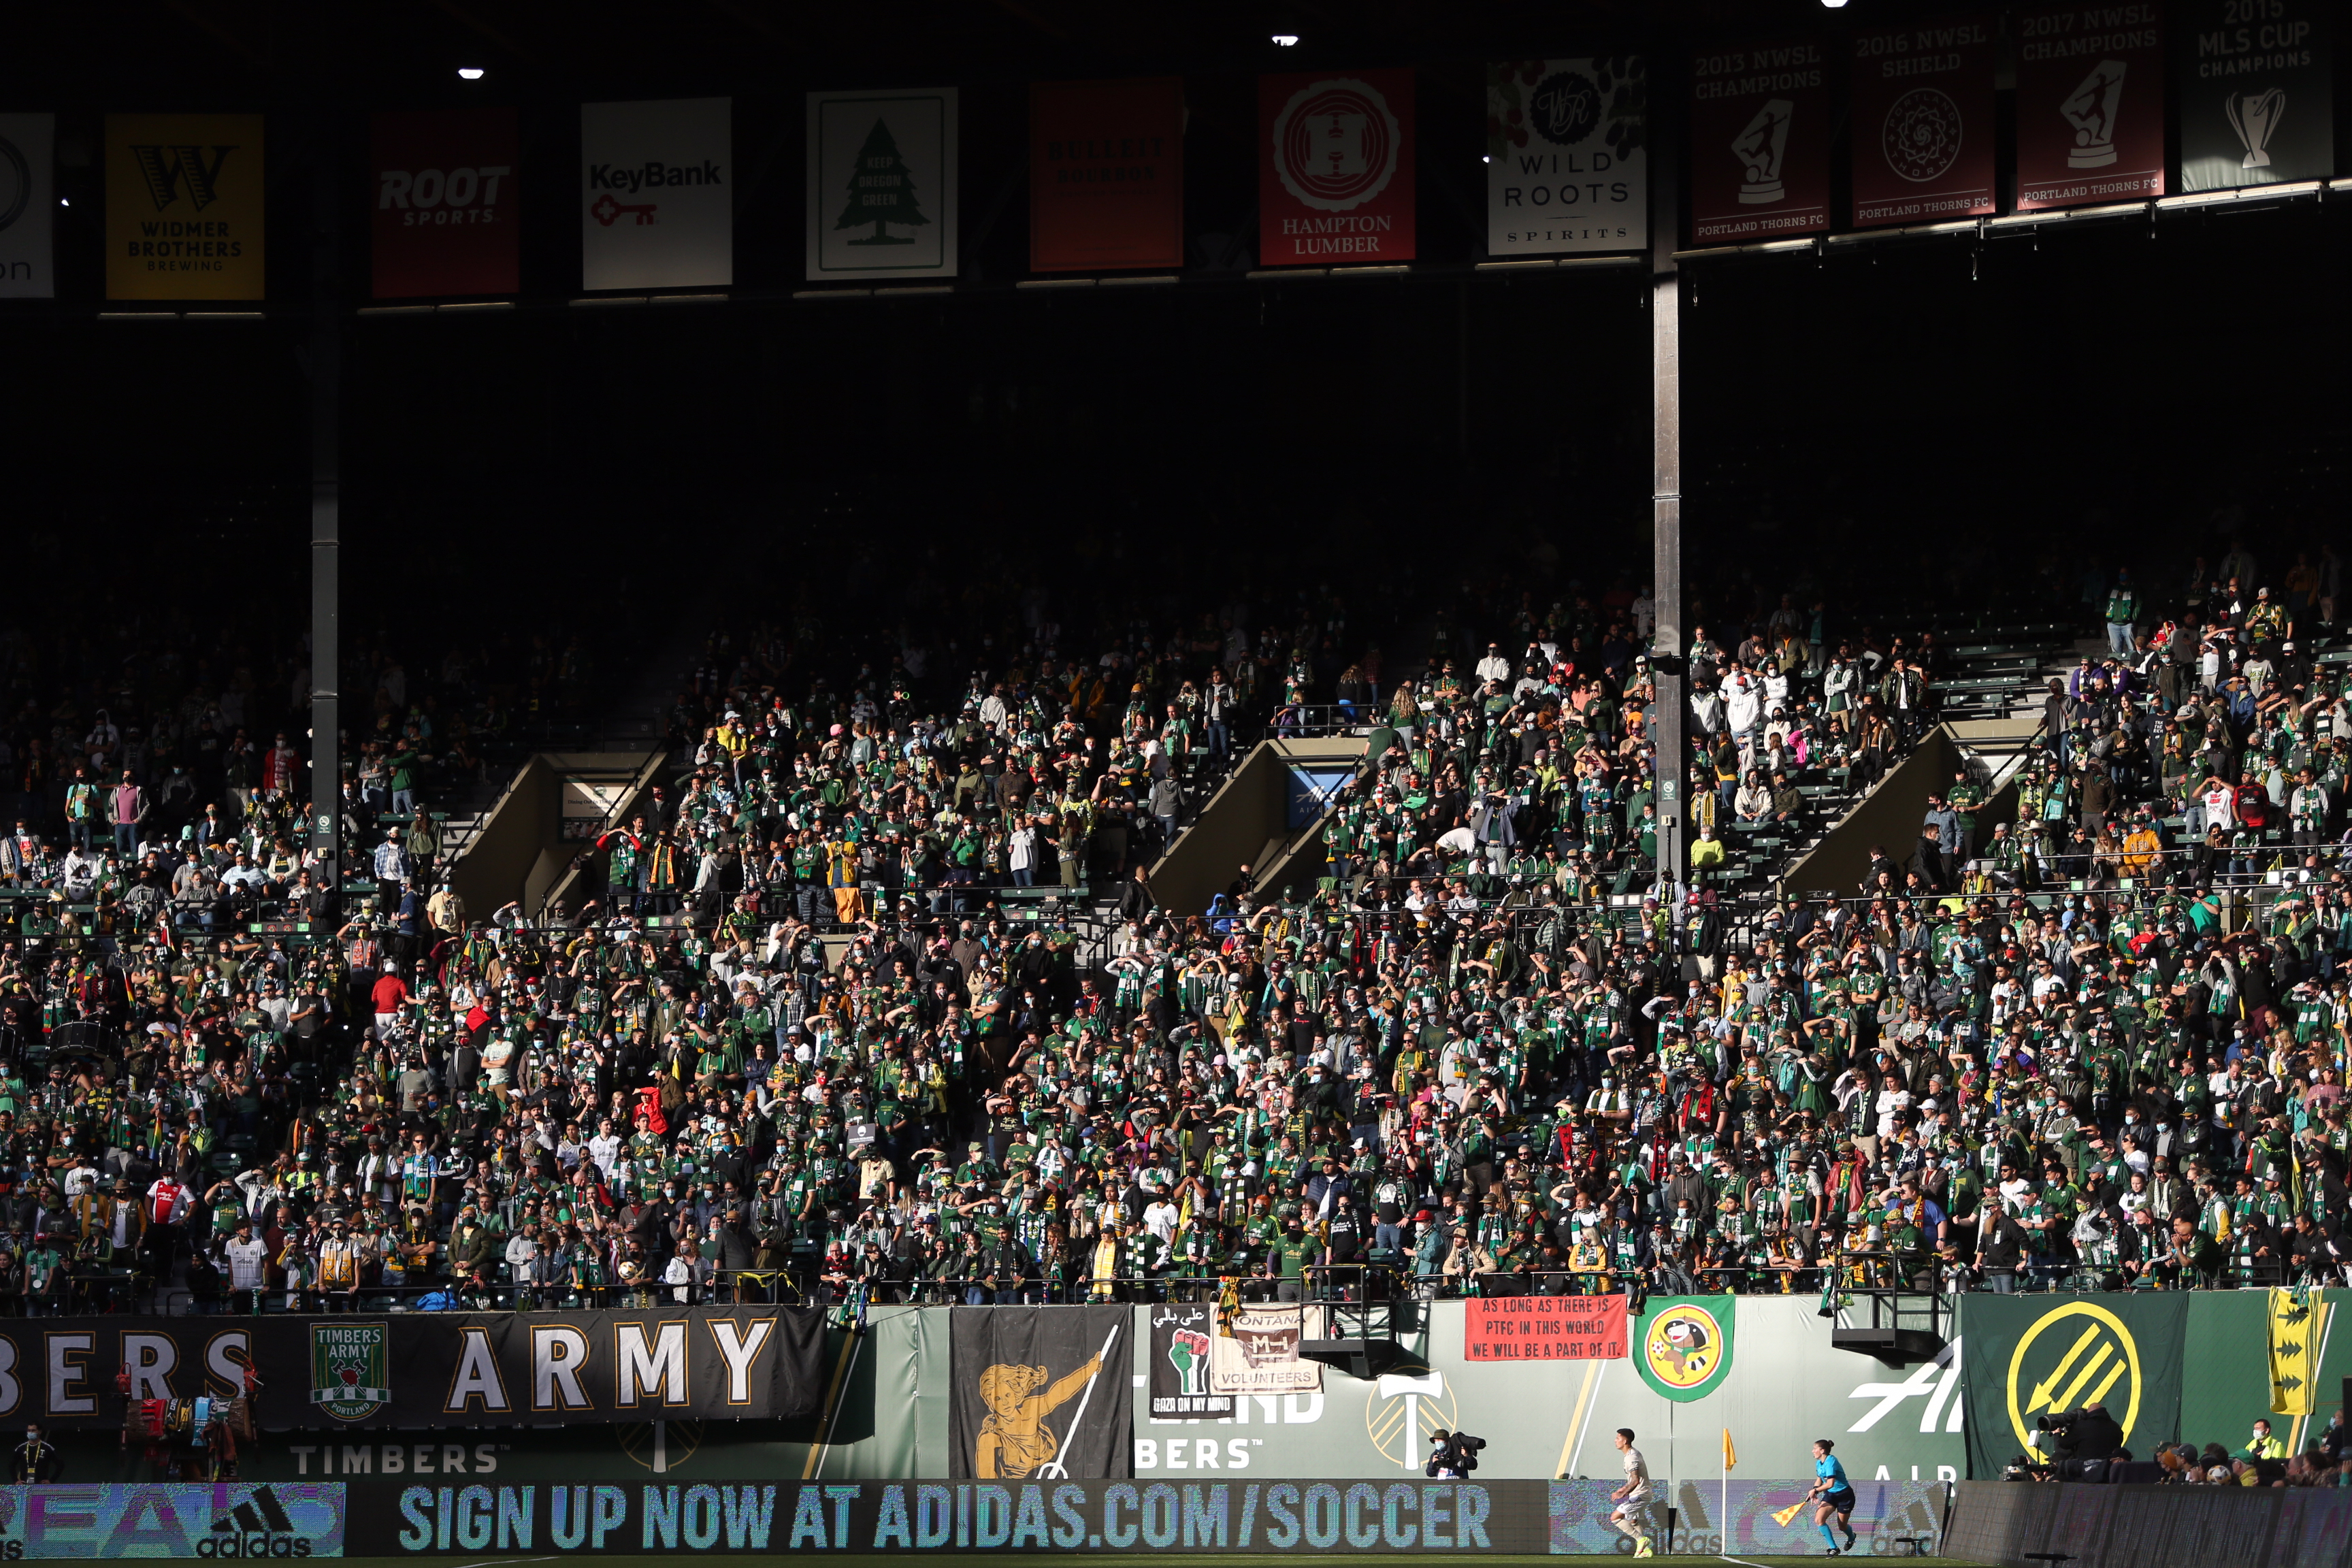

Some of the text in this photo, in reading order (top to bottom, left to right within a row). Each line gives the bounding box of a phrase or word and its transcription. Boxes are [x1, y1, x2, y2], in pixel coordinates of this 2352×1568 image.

[2022, 3, 2156, 37] 2017 NWSL
[2224, 0, 2284, 24] 2015
[1857, 24, 1987, 58] 2016 NWSL
[2022, 29, 2157, 61] CHAMPIONS
[2198, 21, 2310, 58] MLS CUP
[1695, 46, 1821, 77] 2013 NWSL
[1882, 53, 1961, 78] SHIELD
[2199, 50, 2311, 78] CHAMPIONS
[1695, 70, 1822, 100] CHAMPIONS
[866, 156, 894, 170] KEEP
[1518, 152, 1612, 175] WILD
[378, 165, 511, 210] ROOT
[590, 160, 723, 194] KeyBank
[858, 174, 902, 189] OREGON
[862, 193, 898, 207] GREEN
[1504, 182, 1629, 207] ROOTS
[2023, 178, 2158, 202] PORTLAND THORNS FC
[403, 208, 494, 227] SPORTS
[1858, 196, 1989, 220] PORTLAND THORNS FC
[141, 222, 229, 238] WIDMER
[1282, 215, 1392, 235] HAMPTON
[1507, 227, 1628, 243] SPIRITS
[1697, 215, 1824, 237] PORTLAND THORNS FC
[128, 241, 242, 257] BROTHERS
[1294, 236, 1381, 255] LUMBER
[147, 261, 223, 272] BREWING
[1482, 1298, 1609, 1313] AS LONG AS THERE IS
[1153, 1307, 1205, 1328] على بالي
[1486, 1320, 1604, 1335] PTFC IN THIS WORLD
[316, 1328, 382, 1344] TIMBERS
[329, 1344, 370, 1359] ARMY
[1473, 1343, 1488, 1357] WE
[1493, 1343, 1520, 1358] WILL
[1525, 1343, 1539, 1357] BE
[1543, 1343, 1551, 1357] A
[1556, 1342, 1584, 1357] PART
[1590, 1342, 1602, 1357] OF
[442, 1317, 777, 1414] ARMY
[1222, 1371, 1311, 1384] VOLUNTEERS
[331, 1402, 370, 1416] PORTLAND
[1153, 1396, 1230, 1413] GAZA ON MY MIND
[399, 1482, 1492, 1551] SIGN UP NOW AT ADIDAS.COM/SOCCER
[197, 1531, 312, 1558] adidas
